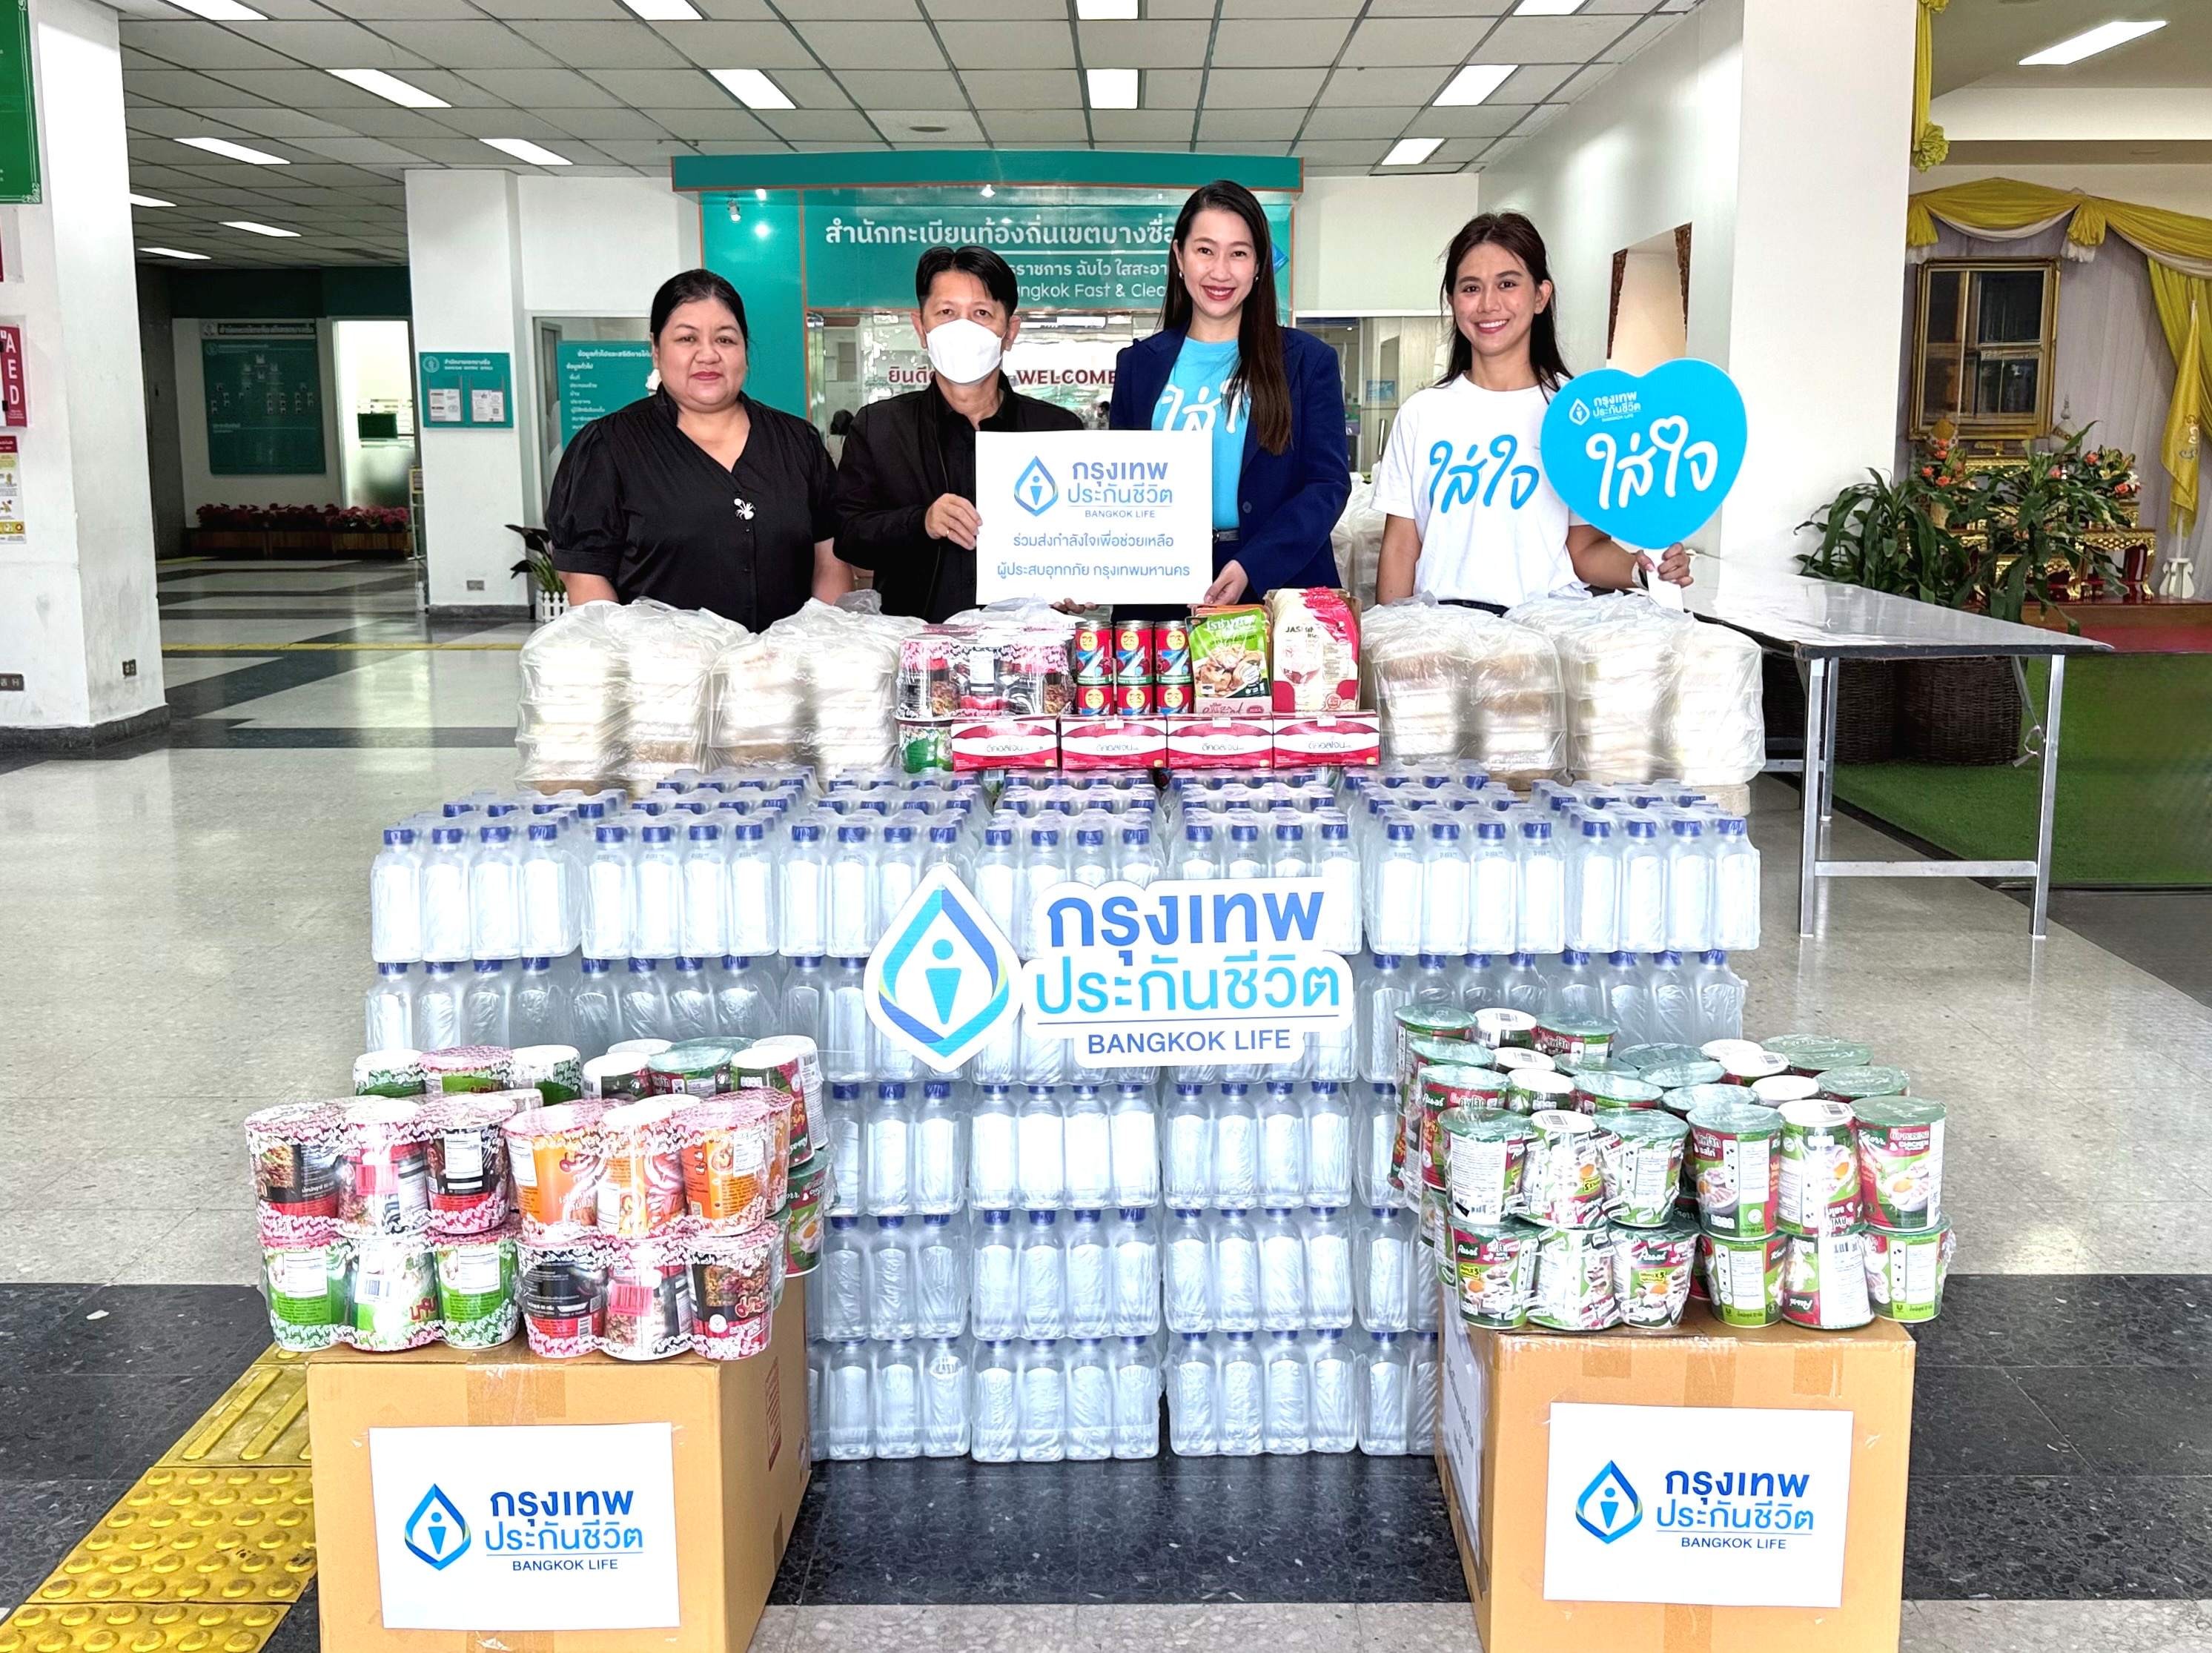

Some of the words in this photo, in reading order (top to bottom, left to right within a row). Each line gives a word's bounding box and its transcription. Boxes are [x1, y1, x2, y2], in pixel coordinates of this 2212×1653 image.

[1076, 259, 1111, 276] ฉับไว
[1115, 259, 1168, 276] ใสสะอา
[1076, 284, 1110, 298] Fast
[1115, 284, 1125, 298] &
[1593, 391, 1637, 408] กรุงเทพ
[1073, 462, 1168, 486] กรุงเทพ
[1429, 434, 1539, 513] ใส่ใจ
[1586, 415, 1718, 509] ใส่ใจ
[1067, 483, 1173, 504] ประกันชีวิต
[1085, 510, 1132, 518] BANGKOK
[1136, 510, 1155, 518] LIFE
[1013, 530, 1174, 547] ร่วมส่งกำลังใจเพื่อช่วยเหลือ
[997, 562, 1090, 580] ผู้ประสบอุทกภัย
[1093, 566, 1191, 580] กรุงเทพมหานคร
[1047, 891, 1325, 966] กรุงเทพ
[1036, 950, 1339, 1014] ประกันชีวิต
[1087, 1030, 1225, 1054] BANGKOK
[1235, 1029, 1291, 1050] LIFE
[1665, 1469, 1809, 1505] กรุงเทพ
[490, 1490, 634, 1527] กรุงเทพ
[1657, 1499, 1815, 1530] ประกันชีวิต
[485, 1520, 643, 1551] ประกันชีวิต
[1680, 1537, 1752, 1548] BANGKOK
[1757, 1538, 1787, 1550] LIFE
[512, 1559, 584, 1571] BANGKOK
[589, 1559, 618, 1570] LIFE
